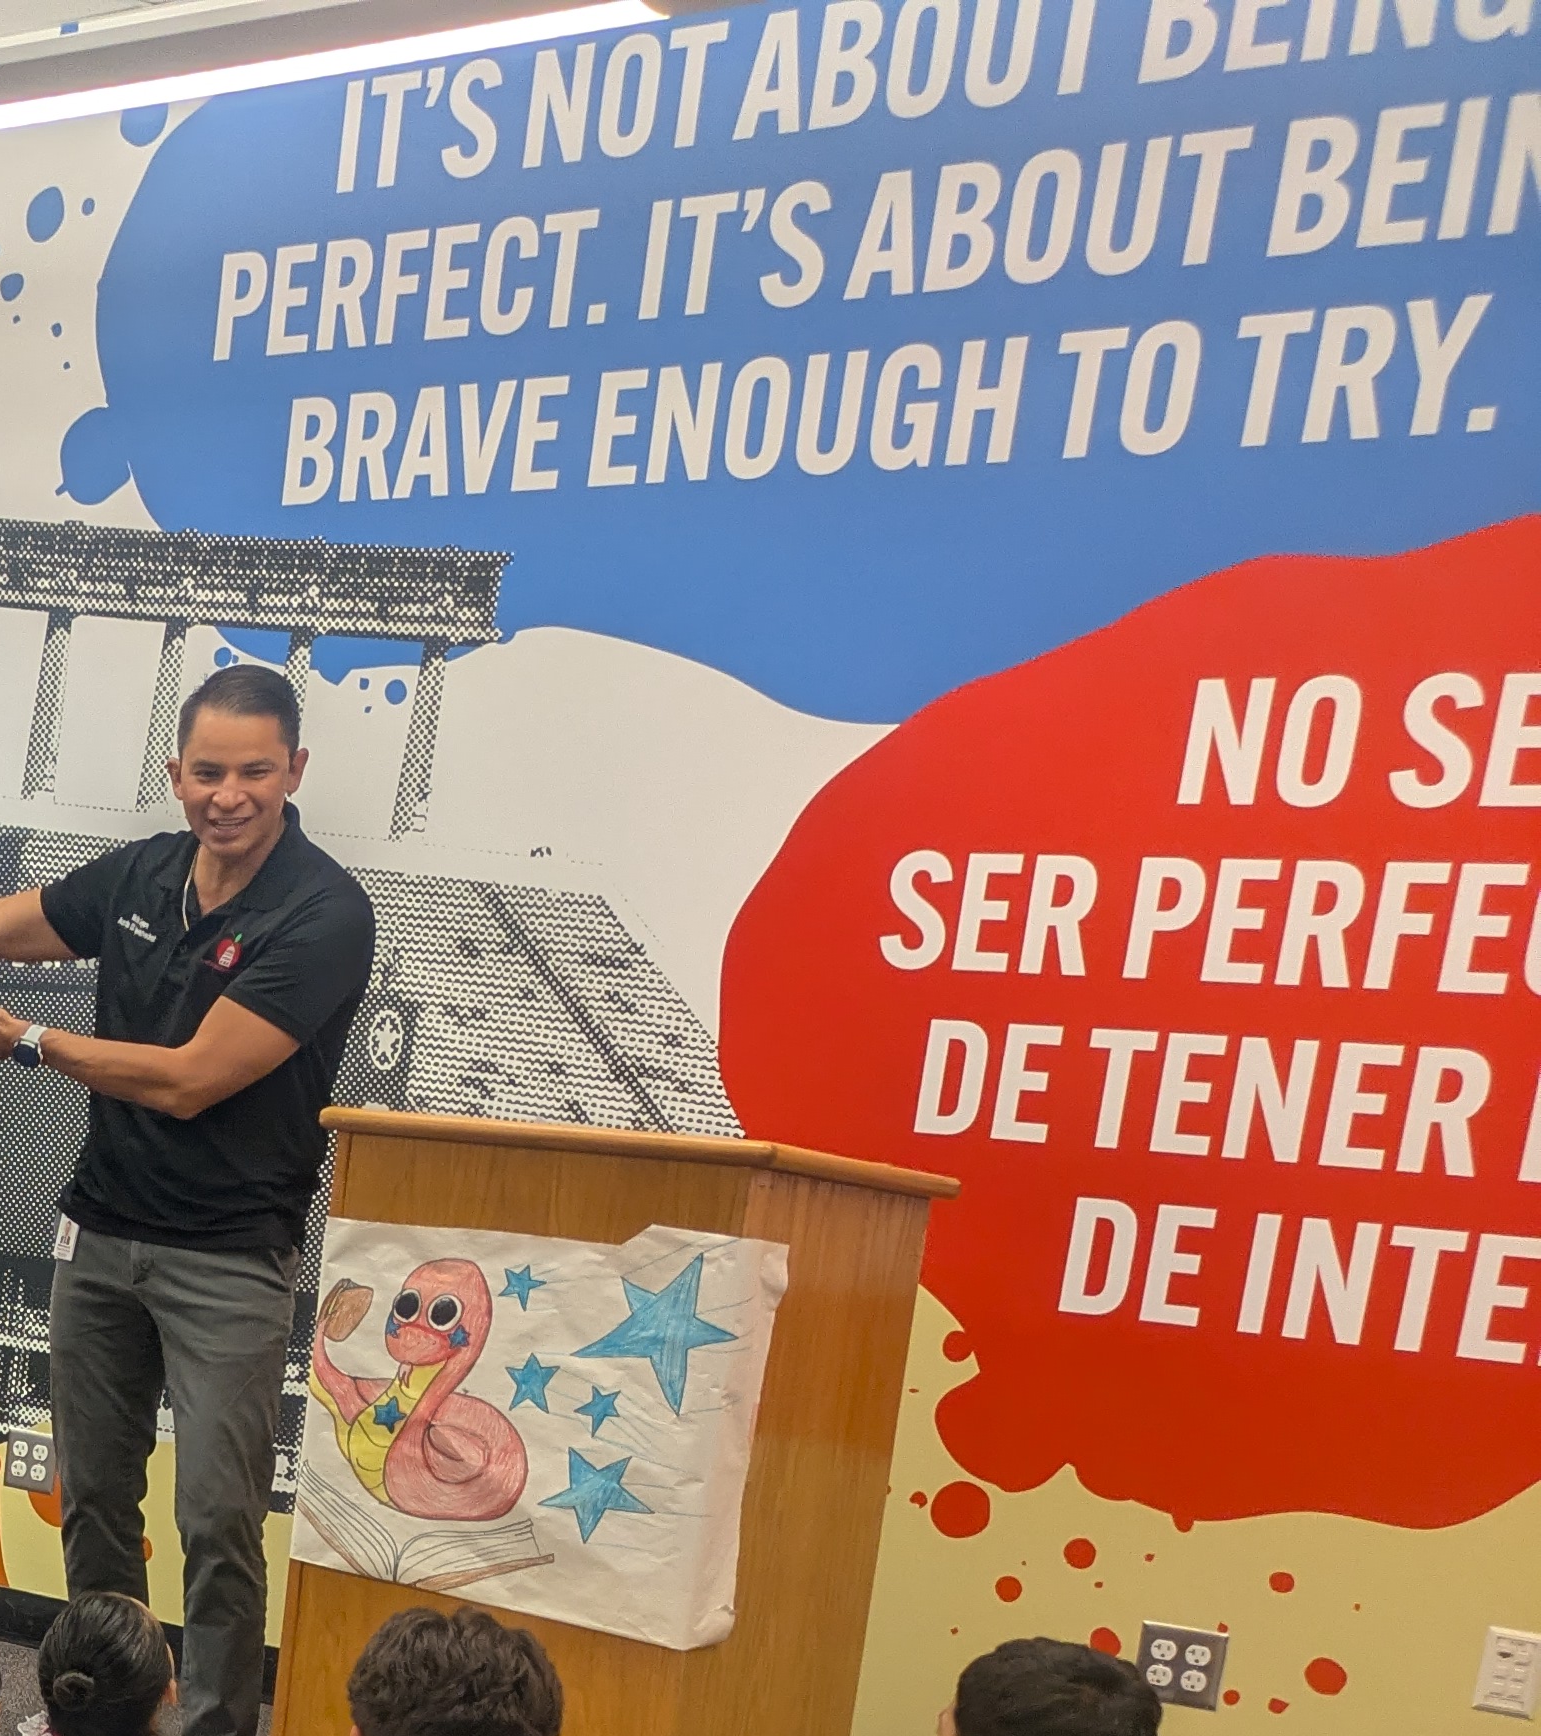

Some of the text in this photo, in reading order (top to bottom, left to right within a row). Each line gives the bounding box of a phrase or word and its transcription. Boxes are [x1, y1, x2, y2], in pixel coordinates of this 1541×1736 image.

[335, 58, 503, 194] IT'S
[521, 20, 729, 170] NOT
[732, 0, 1098, 141] ABOUT
[213, 208, 607, 361] PERFECT.
[638, 181, 832, 320] IT'S
[843, 125, 1255, 300] ABOUT
[282, 294, 1498, 506] BRAVE ENOUGH TO TRY.
[1176, 674, 1363, 808] NO
[879, 849, 1541, 997] SER PERFE
[913, 1018, 1064, 1144] DE
[1089, 1028, 1493, 1178] TENER
[1058, 1196, 1217, 1328] DE
